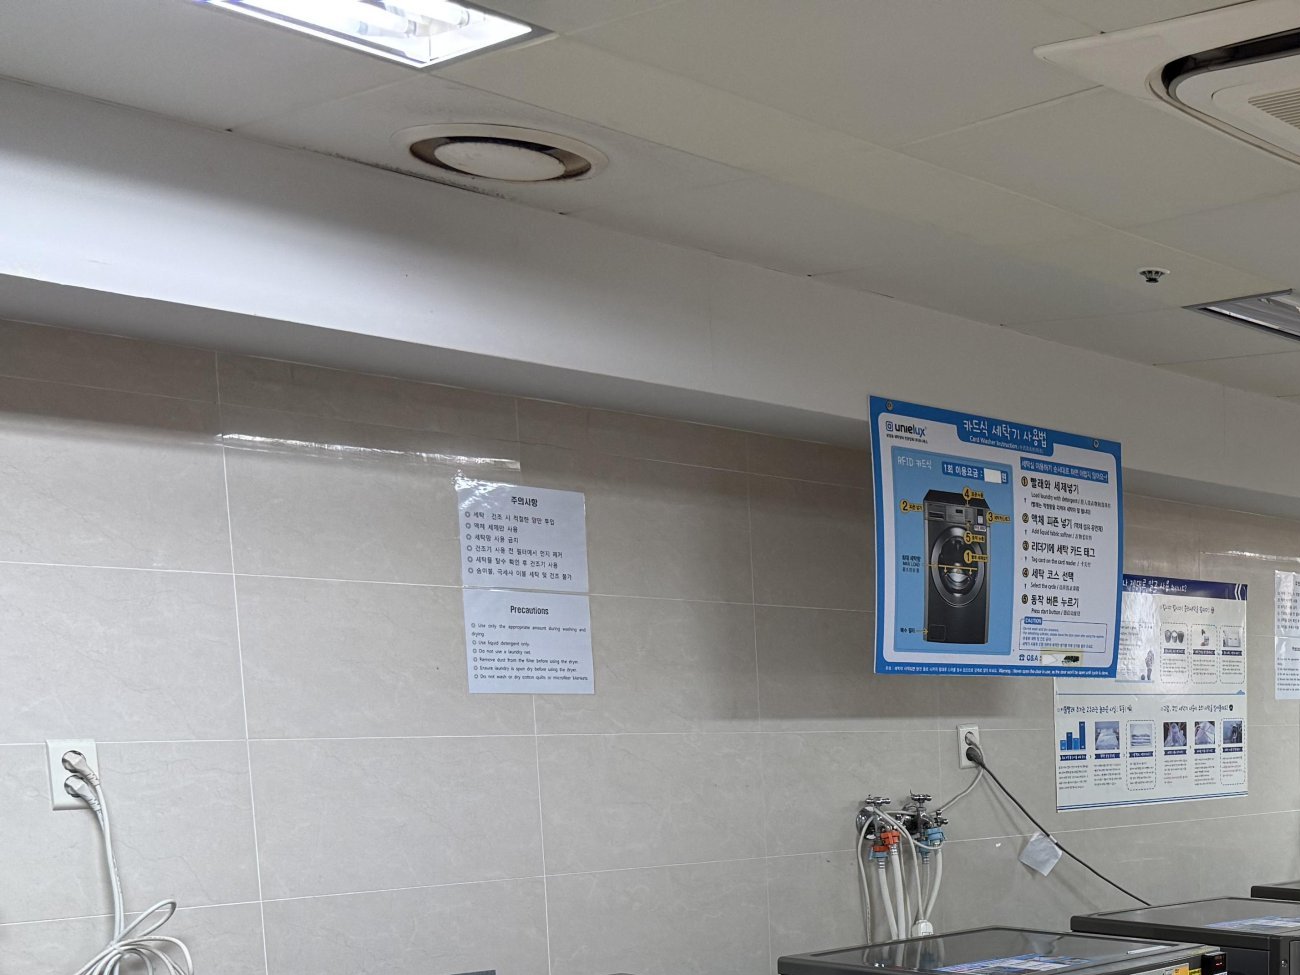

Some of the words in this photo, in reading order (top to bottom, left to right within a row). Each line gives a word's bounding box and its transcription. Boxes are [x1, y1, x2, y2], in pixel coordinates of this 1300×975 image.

[964, 420, 988, 434] 카드식
[992, 424, 1020, 439] 세탁기
[1024, 429, 1046, 447] 사용법
[898, 457, 913, 466] RFID
[916, 459, 932, 470] 카드식
[1031, 478, 1050, 490] 빨래와
[1054, 481, 1079, 494] 세제넣기
[511, 497, 538, 507] 주의사항
[1032, 514, 1044, 525] 액체
[1061, 518, 1072, 529] 넣기
[1032, 542, 1054, 554] 리더기에
[1057, 545, 1068, 555] 세탁
[1070, 546, 1082, 556] 카드
[1084, 548, 1095, 558] 태그
[1032, 568, 1044, 580] 세탁
[1047, 570, 1059, 580] 코스
[1062, 571, 1074, 582] 선택
[1031, 595, 1043, 606] 동작
[1047, 596, 1058, 607] 버튼
[1061, 597, 1078, 608] 누르기
[511, 606, 549, 615] Precautions
